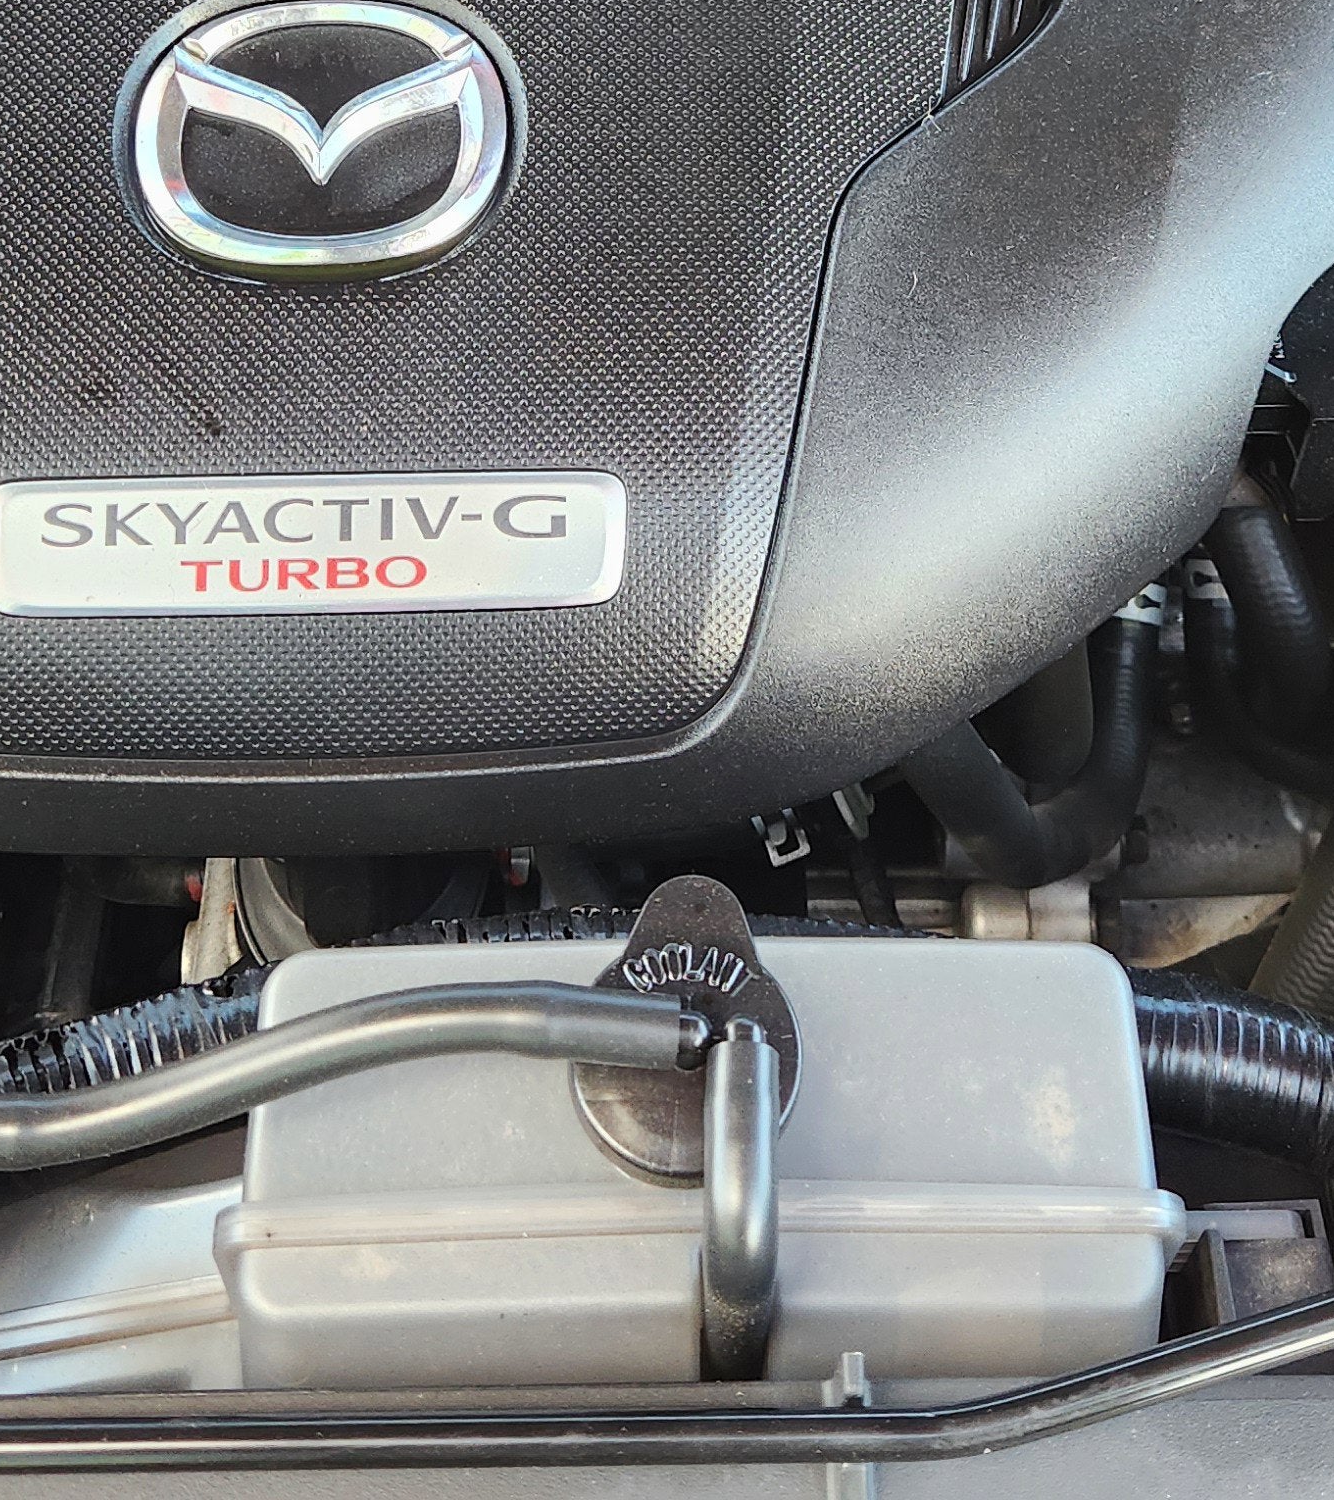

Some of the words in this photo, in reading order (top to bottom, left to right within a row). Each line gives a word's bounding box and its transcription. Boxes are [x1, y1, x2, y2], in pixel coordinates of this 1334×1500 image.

[40, 494, 568, 548] SKYACTIV-G
[180, 555, 428, 593] TURBO
[622, 943, 761, 998] COOLANT
